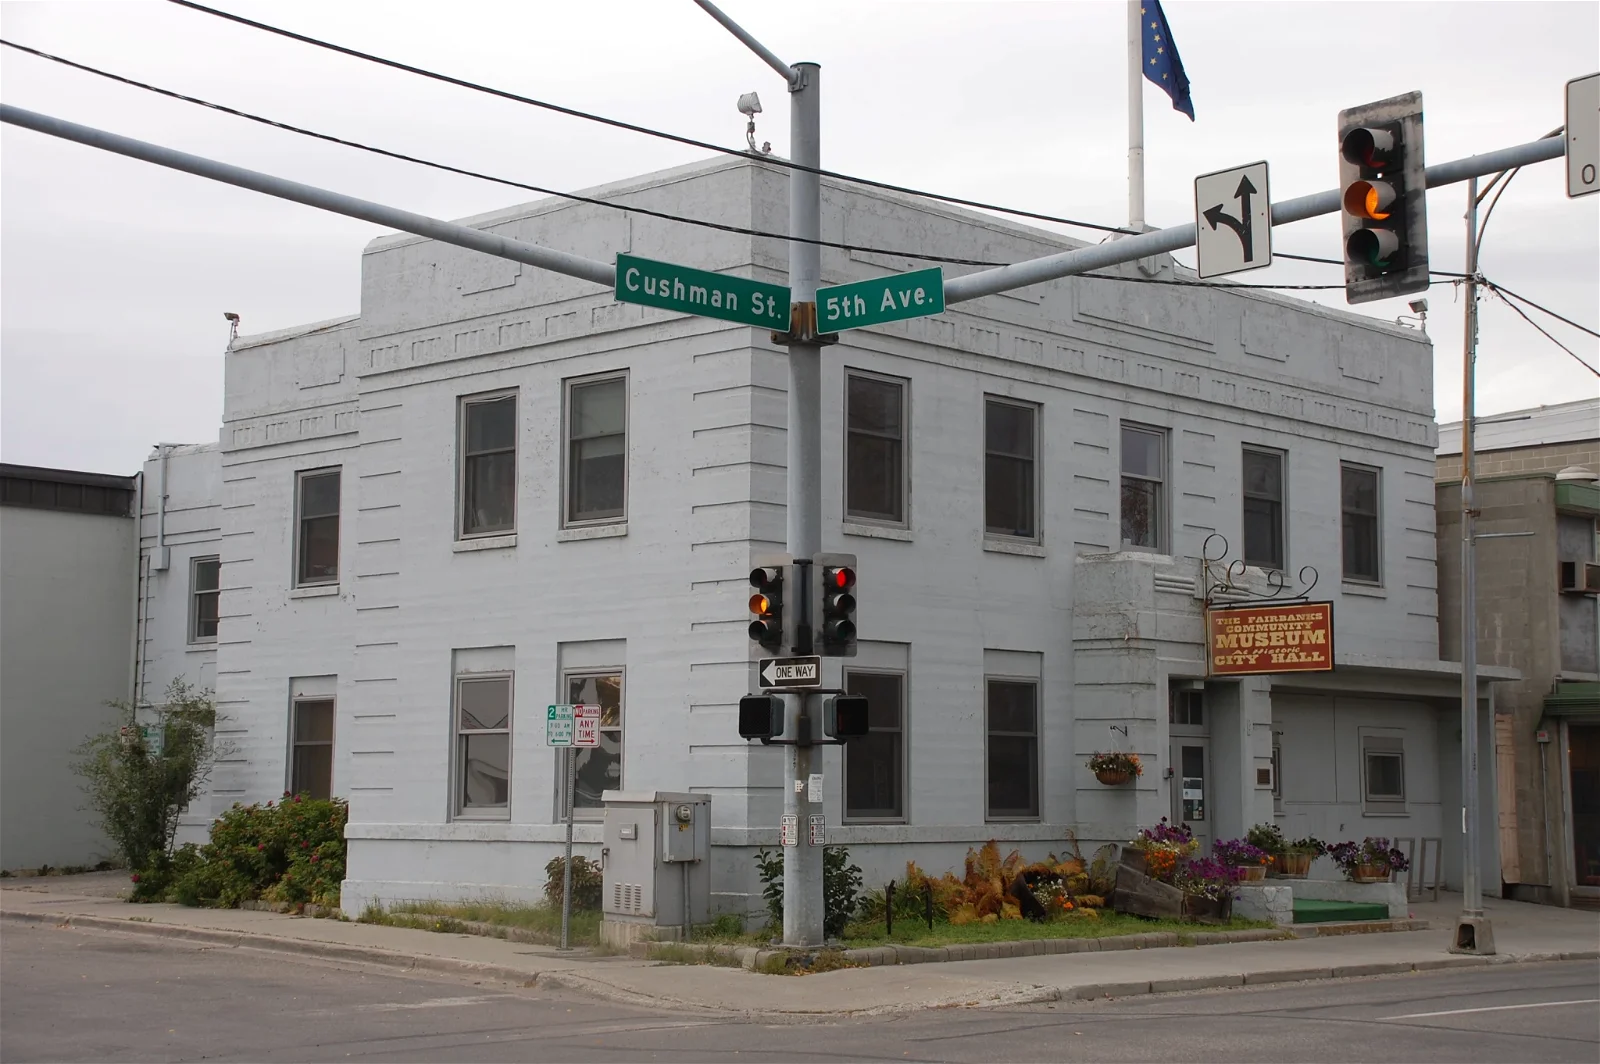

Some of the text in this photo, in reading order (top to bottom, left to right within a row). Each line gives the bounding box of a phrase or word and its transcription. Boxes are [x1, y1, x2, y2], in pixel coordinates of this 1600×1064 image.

[625, 267, 782, 319] Cushman St.
[827, 286, 933, 320] 5th Ave.
[1215, 612, 1323, 625] THE FAIRBANKS
[1226, 621, 1314, 633] COMMUNITY
[1215, 629, 1326, 649] MUSEUM
[1214, 651, 1325, 666] CITY HALL
[776, 665, 813, 678] ONE WAY
[548, 707, 555, 718] 2
[580, 720, 594, 728] ANY
[579, 730, 595, 738] TIME
